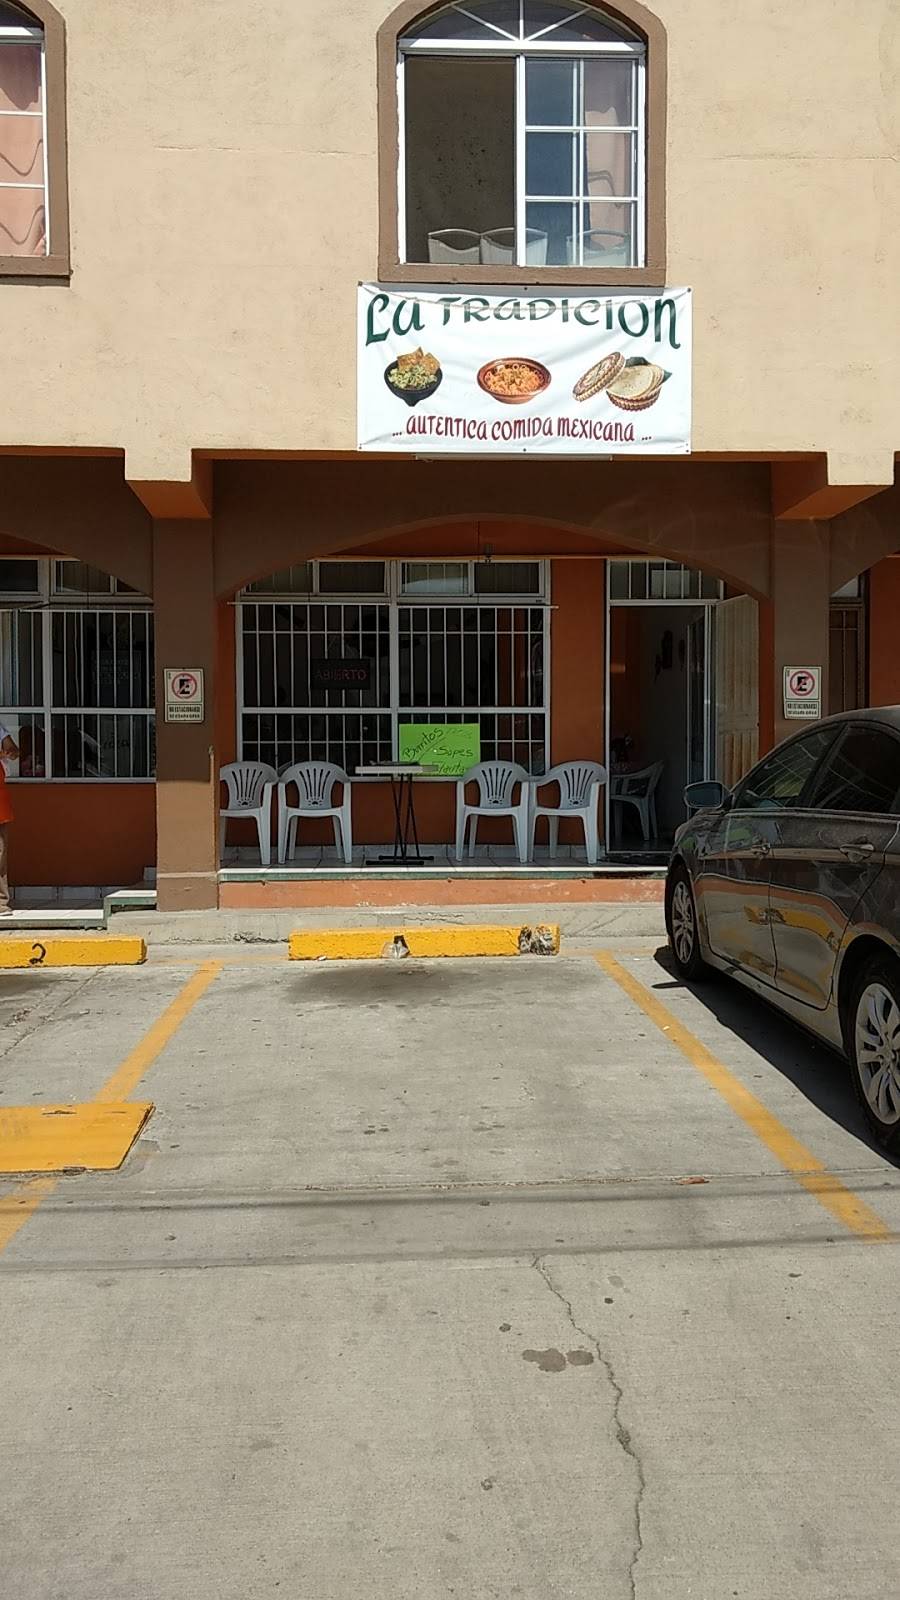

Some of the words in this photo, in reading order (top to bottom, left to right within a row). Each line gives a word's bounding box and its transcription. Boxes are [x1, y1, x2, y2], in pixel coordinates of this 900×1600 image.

[406, 415, 487, 442] AUTENTICA
[491, 417, 553, 442] COMIDA
[557, 418, 634, 442] MEXICANA
